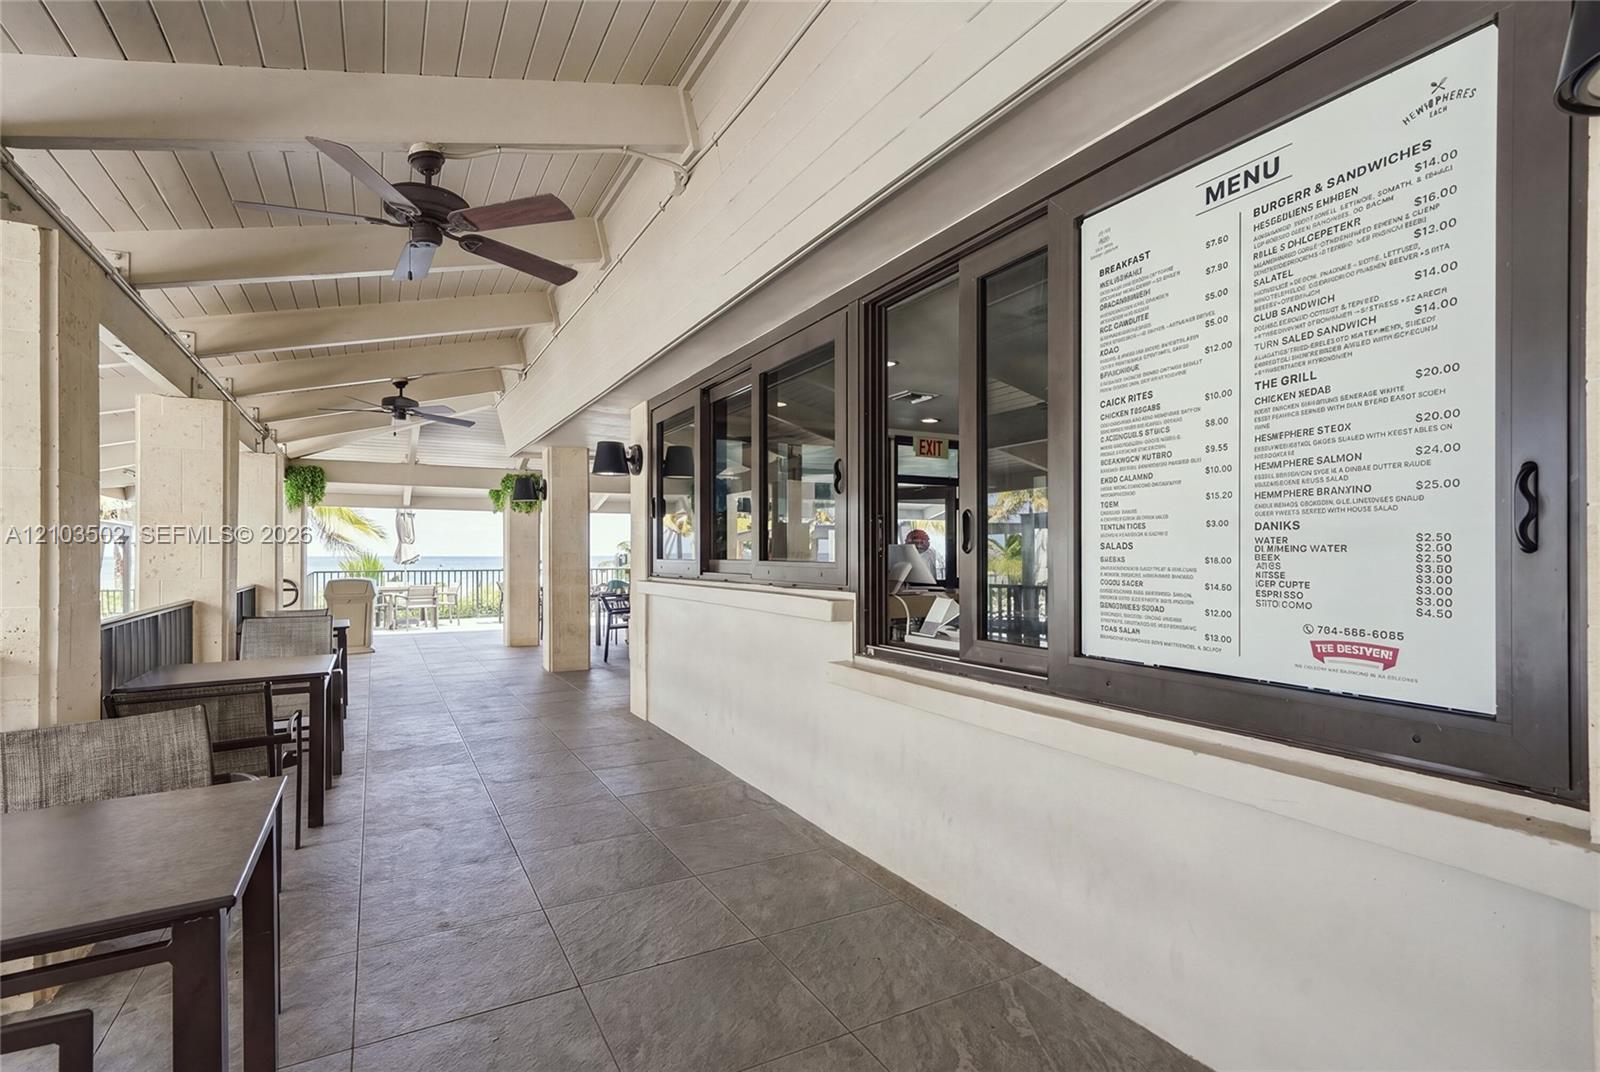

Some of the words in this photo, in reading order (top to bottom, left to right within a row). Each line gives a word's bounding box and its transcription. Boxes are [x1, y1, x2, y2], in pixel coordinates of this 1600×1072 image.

[1414, 149, 1458, 173] $14.00
[1206, 156, 1280, 205] MENU
[1253, 187, 1311, 218] BURGERR
[1314, 183, 1323, 193] &
[1327, 139, 1432, 189] SANDWICHES
[1414, 184, 1457, 207] $16.00
[1099, 250, 1151, 277] BREAKFAST
[1414, 261, 1458, 280] $14.00
[1205, 288, 1228, 301] $5.00
[1253, 309, 1278, 323] CLUB
[1280, 294, 1335, 316] SANDWICH
[1414, 297, 1458, 314] $14.00
[1205, 315, 1228, 328] $5.00
[1254, 339, 1279, 351] TURN
[1282, 330, 1314, 345] SALED
[1317, 315, 1376, 337] SANDWICH
[1204, 340, 1232, 354] $12.00
[1415, 362, 1460, 378] $20.00
[1254, 377, 1278, 390] THE
[1281, 371, 1317, 386] GRILL
[1100, 396, 1126, 408] CAICK
[1128, 390, 1153, 403] RITES
[1205, 388, 1232, 401] $10.00
[1254, 391, 1296, 405] CHICKEN
[1100, 409, 1129, 421] CHICKEN
[1415, 408, 1461, 423] $20.00
[1205, 416, 1229, 427] $8.00
[919, 439, 943, 456] EXIT
[1205, 443, 1228, 453] $9.55
[1415, 442, 1461, 455] $24.00
[1316, 452, 1362, 464] SALMON
[1205, 464, 1232, 474] $10.00
[1416, 478, 1460, 490] $25.00
[1205, 491, 1233, 500] $15.20
[1206, 519, 1229, 528] $3.00
[1254, 520, 1300, 531] DANIKS
[1254, 536, 1288, 544] WATER
[1416, 532, 1452, 542] $2.50
[1100, 542, 1134, 550] SALADS
[1309, 544, 1347, 552] WATER
[1254, 553, 1280, 561] BEEK
[1416, 553, 1452, 563] $2.50
[1278, 580, 1310, 589] CUPTE
[1416, 574, 1453, 585] $3.00
[1416, 585, 1453, 596] $3.00
[1416, 596, 1453, 607] $3.00
[1416, 608, 1453, 619] $4.50
